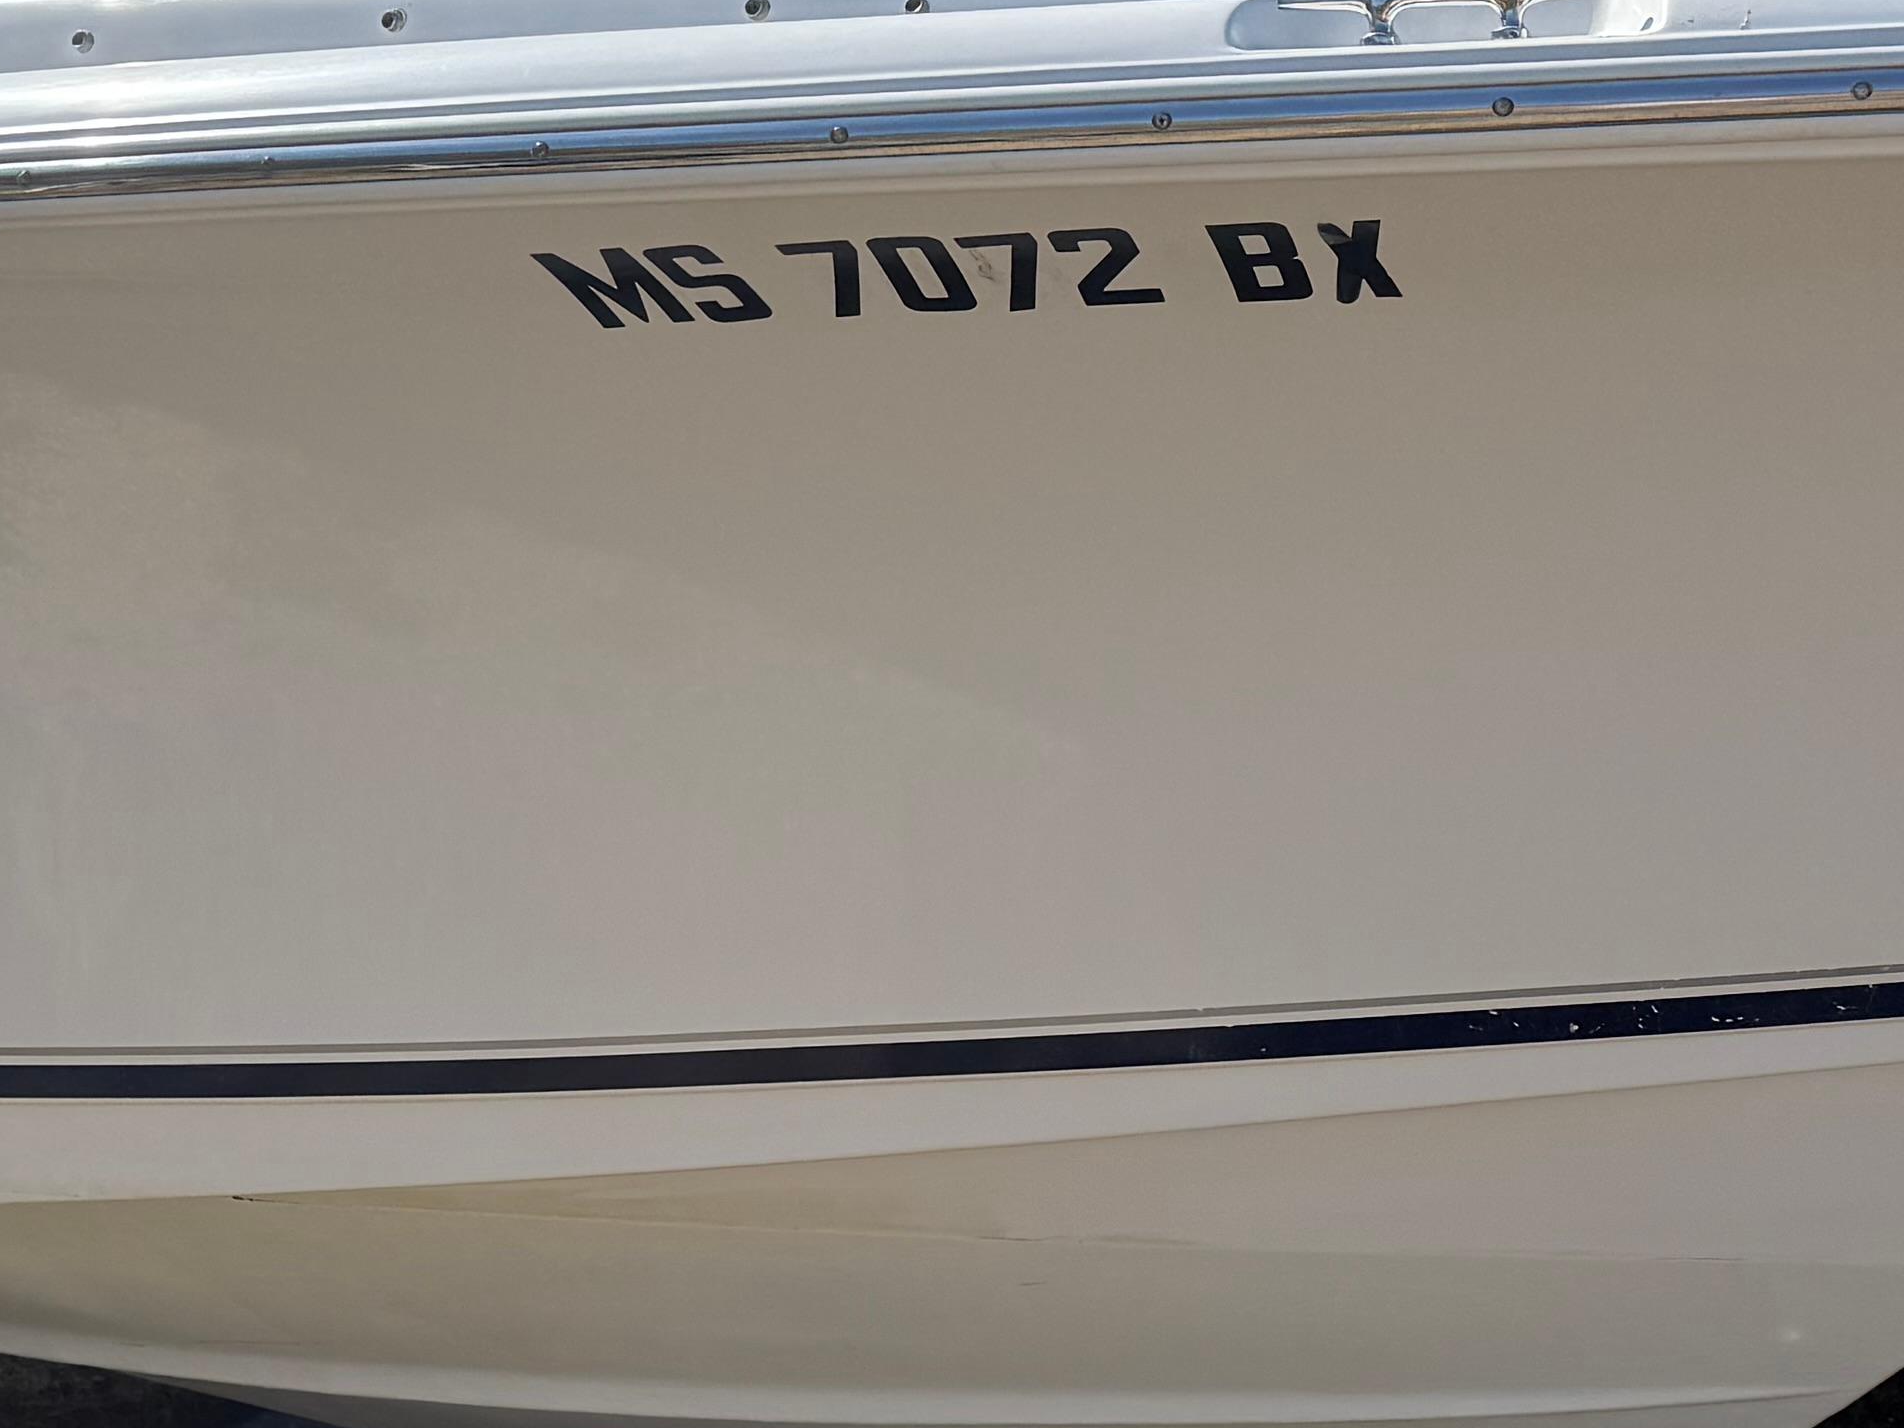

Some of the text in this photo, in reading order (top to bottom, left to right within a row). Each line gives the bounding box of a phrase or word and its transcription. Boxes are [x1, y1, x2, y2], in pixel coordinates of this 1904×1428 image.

[531, 219, 1403, 329] MS 7072 BX
